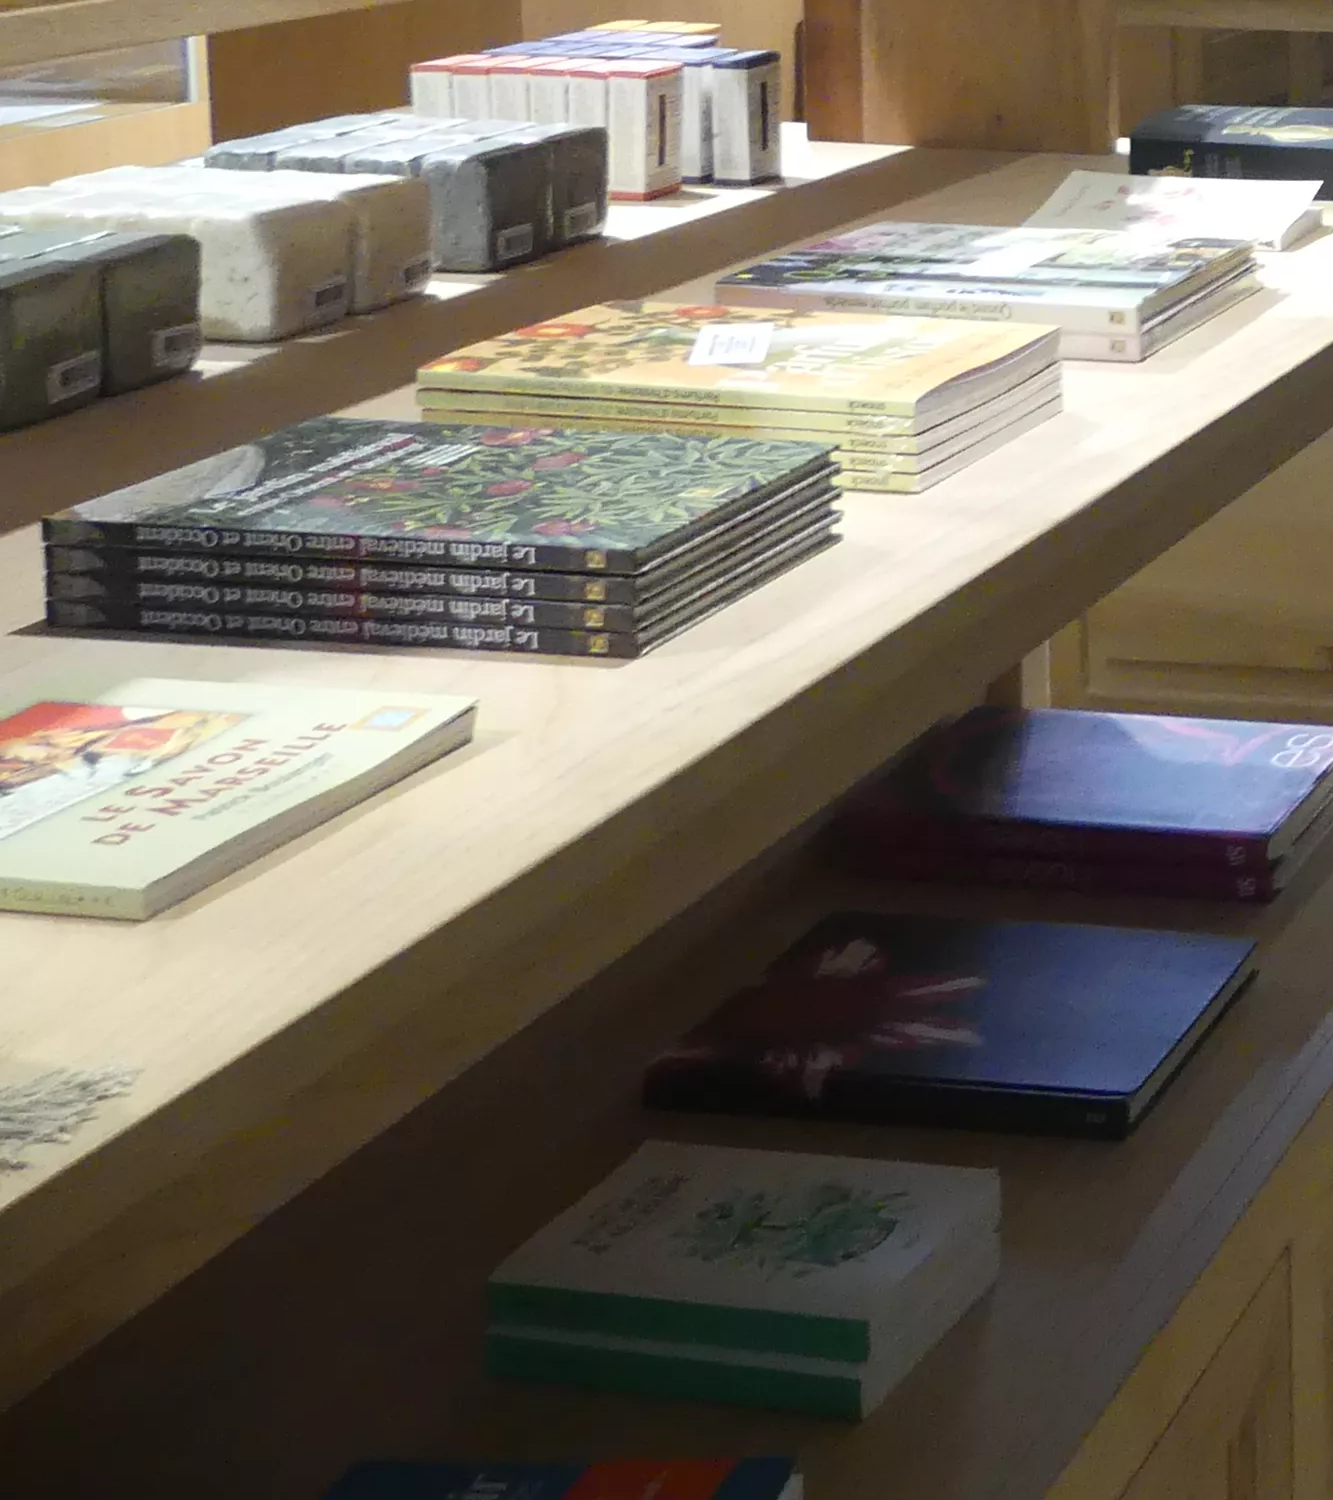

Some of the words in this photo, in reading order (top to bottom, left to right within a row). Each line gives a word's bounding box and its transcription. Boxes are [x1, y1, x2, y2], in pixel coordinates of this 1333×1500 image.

[136, 526, 218, 547] Occident
[221, 530, 240, 547] et
[244, 531, 303, 553] Orient
[307, 535, 355, 552] entre
[360, 537, 444, 560] médiéval
[449, 540, 510, 563] jardin
[512, 545, 536, 564] Le
[137, 556, 219, 578] Occident
[222, 562, 241, 577] et
[246, 562, 303, 583] Orient
[307, 566, 356, 582] entre
[360, 567, 445, 591] médiéval
[449, 571, 510, 595] jardin
[512, 576, 536, 596] Le
[137, 583, 219, 605] Occident
[223, 589, 242, 604] et
[246, 589, 302, 610] Orient
[306, 594, 355, 610] entre
[360, 594, 443, 617] médiéval
[449, 598, 509, 622] jardin
[511, 604, 535, 624] Le
[140, 610, 221, 632] Occident
[225, 615, 244, 631] et
[247, 616, 306, 637] Orient
[310, 620, 358, 637] entre
[361, 621, 448, 644] médiéval
[452, 624, 513, 648] jardin
[514, 630, 538, 650] Le
[82, 805, 136, 822] LE
[126, 738, 268, 798] SAVON
[92, 822, 155, 845] DE
[147, 722, 346, 817] MARSEILLE
